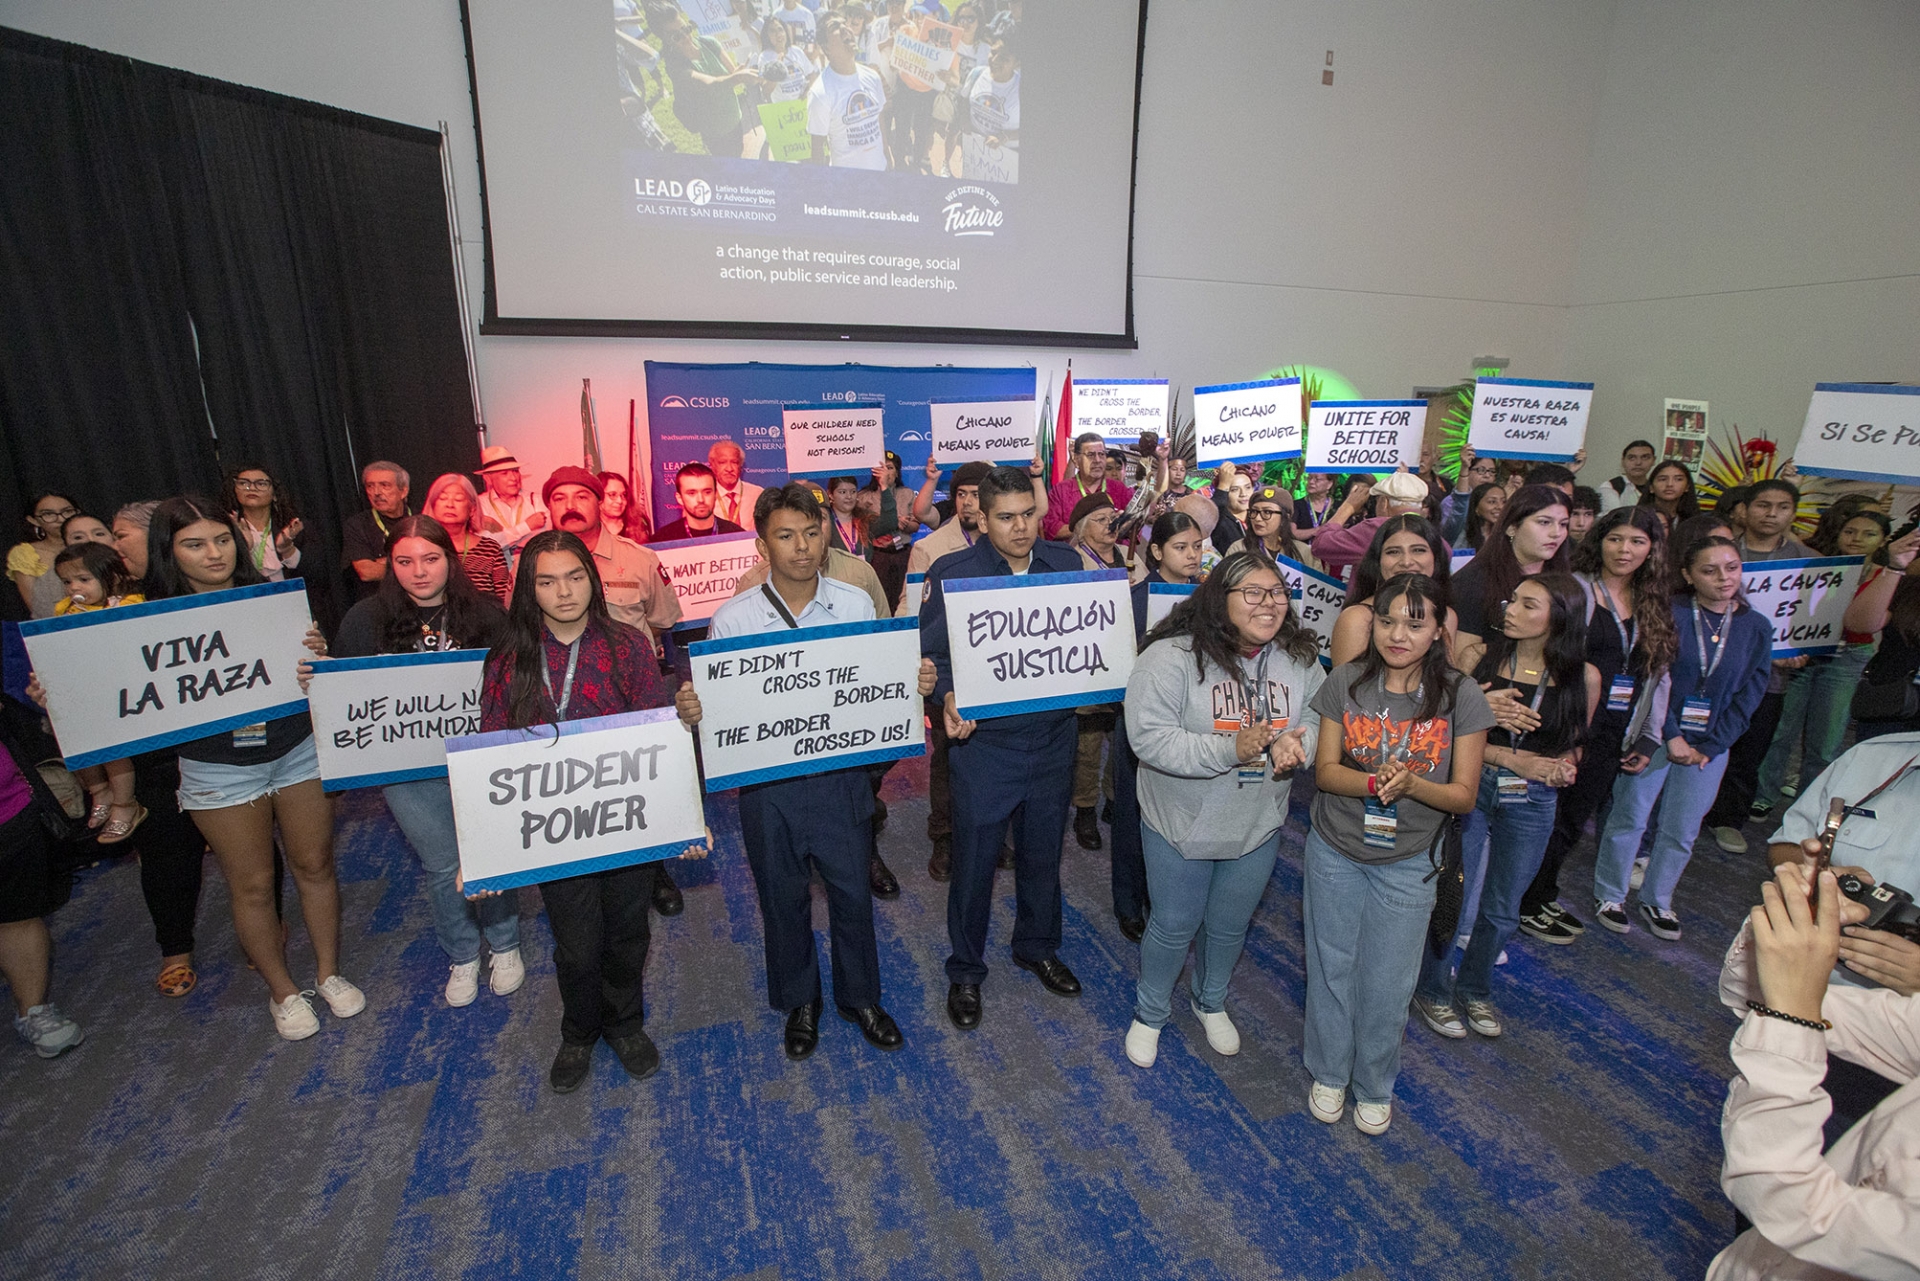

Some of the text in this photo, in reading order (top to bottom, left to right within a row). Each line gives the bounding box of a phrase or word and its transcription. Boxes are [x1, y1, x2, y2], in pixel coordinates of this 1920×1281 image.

[896, 33, 941, 62] FAMILIES
[893, 58, 935, 84] TOGETHER
[634, 178, 684, 198] LEAD
[715, 184, 775, 196] Latino Education
[945, 186, 1000, 207] WE DEFINE THE
[724, 194, 757, 204] Advocacy
[758, 197, 776, 206] Days
[636, 204, 777, 222] CAL STATE SAN BERNARDINO
[804, 203, 920, 223] leadsummit.csusb.edu
[942, 202, 1004, 233] Future
[716, 243, 961, 271] a change that requires courage, social
[720, 265, 958, 293] action, public service and leadership.
[690, 397, 730, 408] CSUSB
[822, 392, 844, 401] LEAD
[1078, 388, 1119, 397] WE DIDN'T
[1099, 398, 1141, 406] CROSS THE
[1128, 408, 1161, 417] BORDER,
[1483, 396, 1580, 411] NUESTRA RAZA
[790, 419, 877, 430] OUR CHILDREN NEED
[1078, 417, 1127, 426] THE BORDER
[1324, 410, 1411, 427] UNITE FOR
[1490, 412, 1568, 426] ES NUESTRA
[744, 427, 767, 436] LEAD
[816, 433, 855, 443] SCHOOLS
[1109, 427, 1144, 436] CROSSED
[1201, 425, 1299, 447] MEANS POWER
[1332, 430, 1399, 446] BETTER
[1504, 429, 1551, 441] CAUSA!
[1852, 424, 1888, 443] Se
[807, 445, 865, 457] NOT PRISONS!
[938, 437, 1035, 451] MEANS POWER
[1327, 449, 1399, 464] SCHOOLS
[673, 562, 706, 578] WANT
[709, 555, 759, 574] BETTER
[1746, 571, 1844, 594] LA CAUSA
[1307, 583, 1345, 607] CAUS
[1303, 605, 1323, 622] ES
[1774, 599, 1802, 618] ES
[967, 599, 1116, 647] EDUCACIÓN
[1772, 623, 1832, 643] LUCHA
[141, 630, 230, 672] VIVA
[708, 650, 804, 681] WE DIDN'T
[987, 643, 1109, 683] JUSTICIA
[119, 658, 272, 718] LA RAZA
[762, 665, 860, 695] CROSS THE
[833, 682, 910, 708] BORDER,
[347, 695, 389, 723] WE
[395, 692, 457, 717] WILL
[333, 715, 481, 750] BE INTIMIDA
[714, 713, 831, 749] THE BORDER
[793, 718, 911, 757] CROSSED US!
[488, 744, 667, 806] STUDENT
[520, 795, 648, 849] POWER
